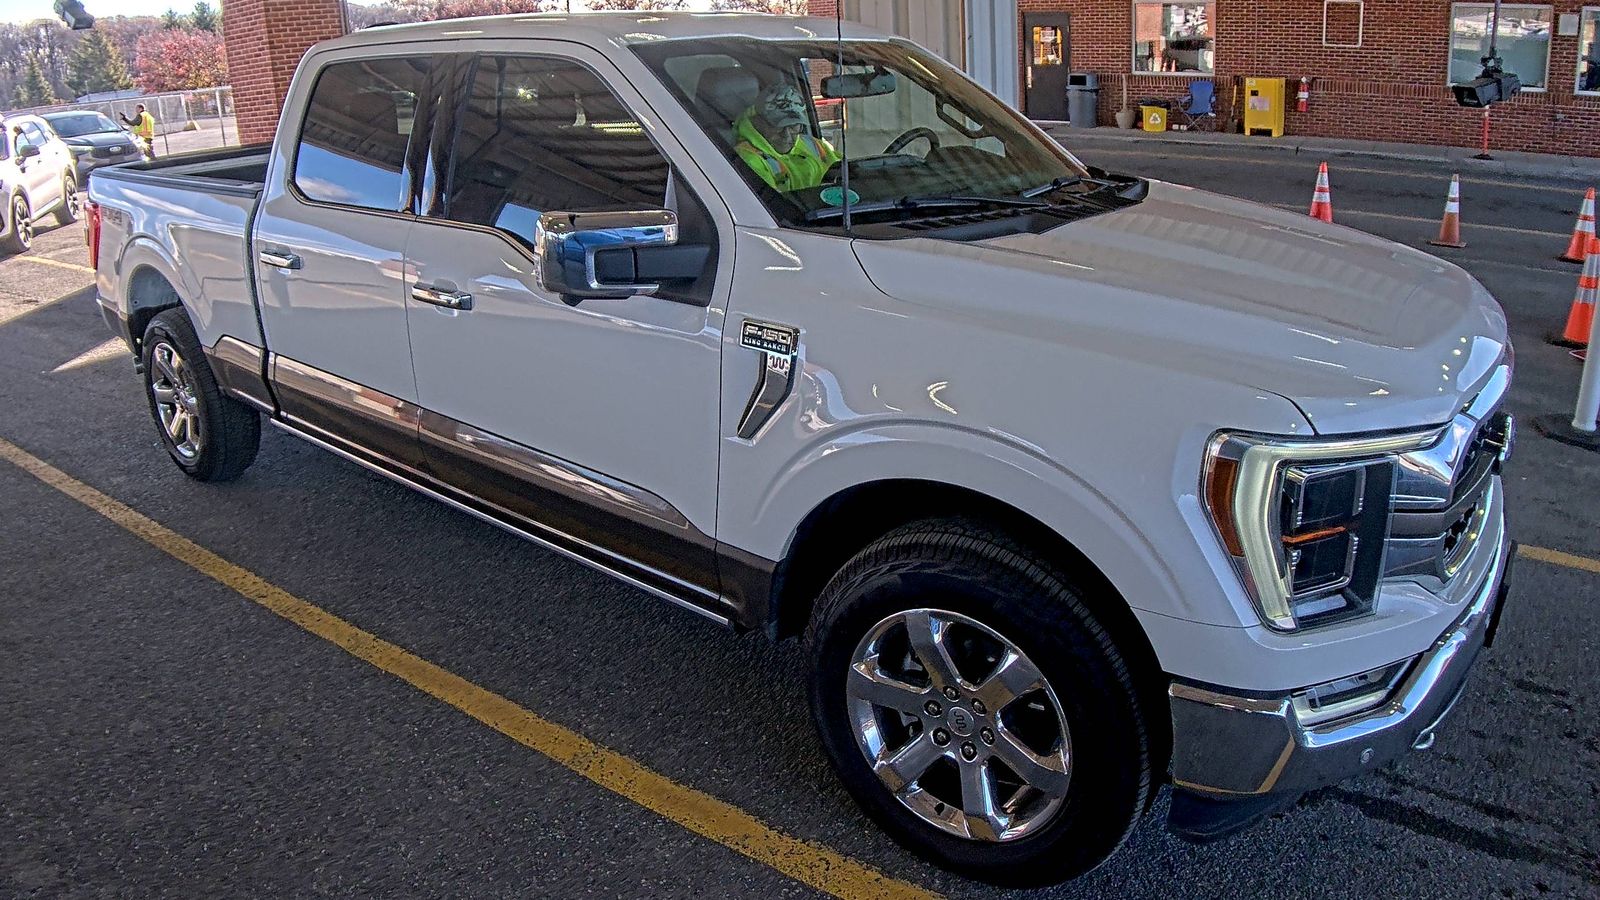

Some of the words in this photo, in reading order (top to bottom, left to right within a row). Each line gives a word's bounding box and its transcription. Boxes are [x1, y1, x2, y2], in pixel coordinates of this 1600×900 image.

[744, 325, 791, 345] F-150
[744, 336, 761, 346] KING
[763, 341, 786, 352] RANCH
